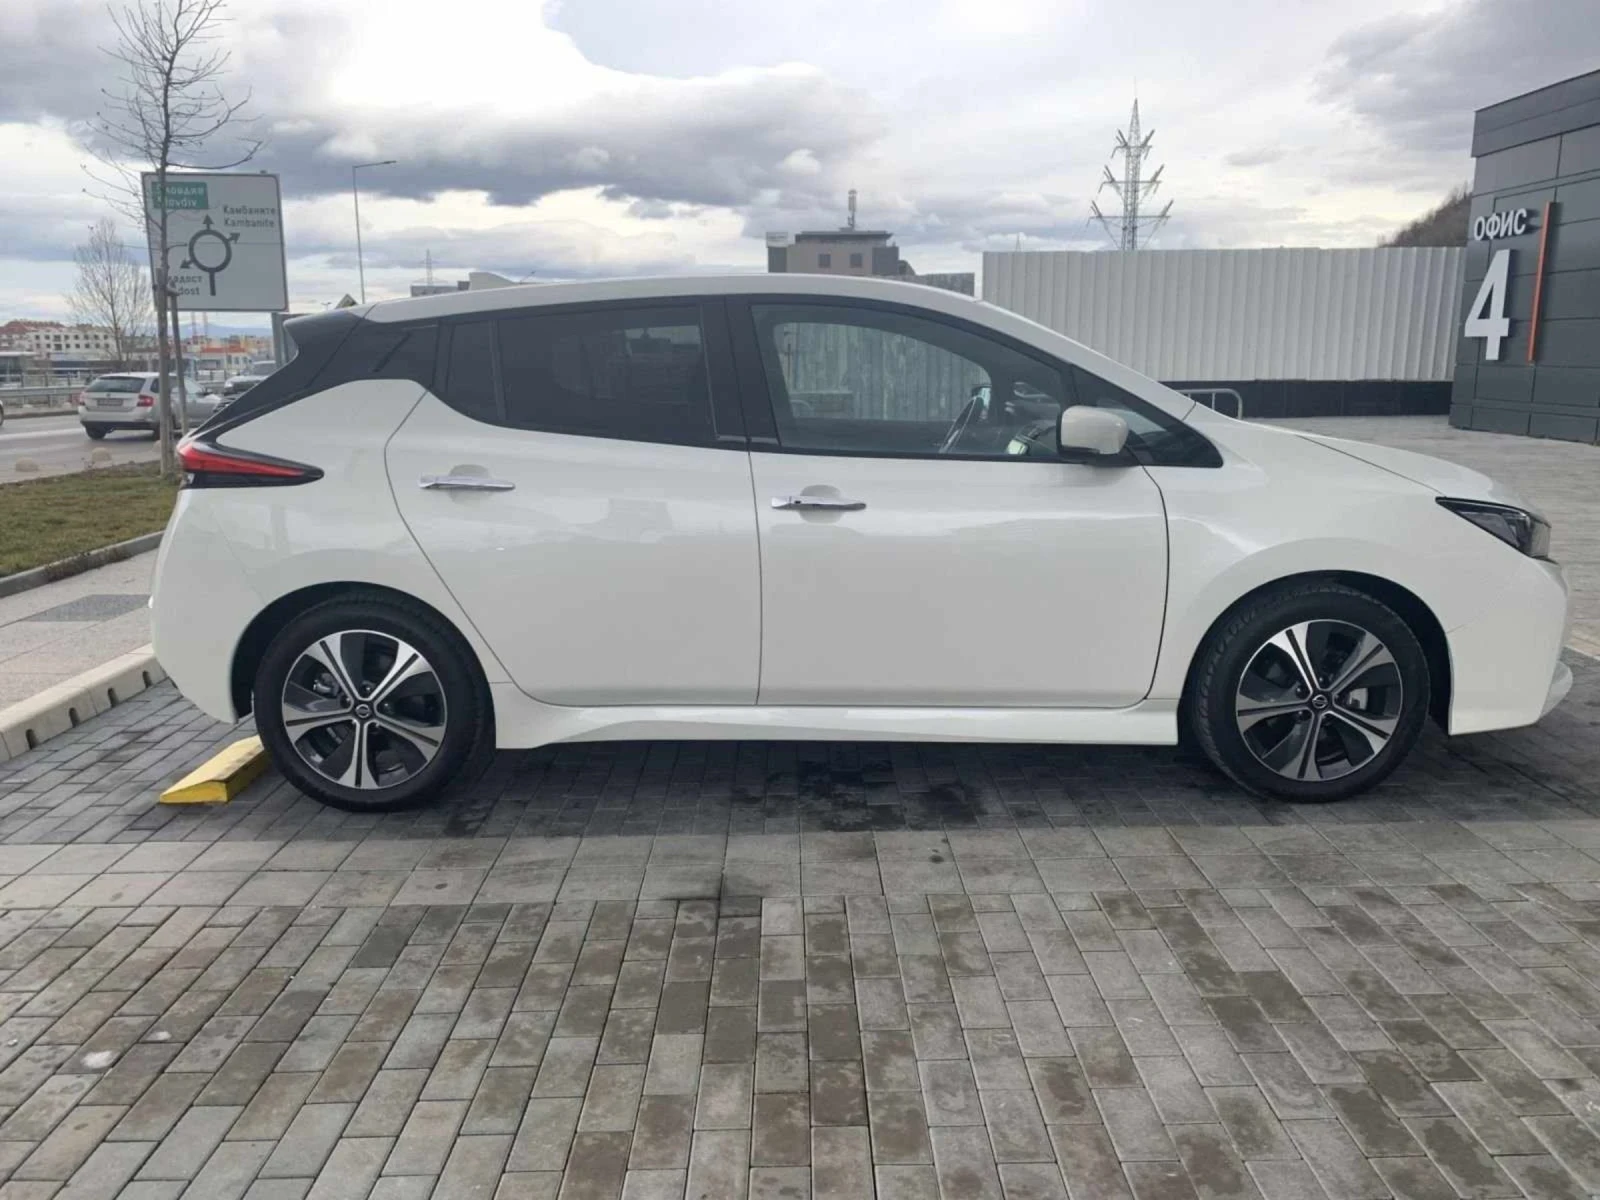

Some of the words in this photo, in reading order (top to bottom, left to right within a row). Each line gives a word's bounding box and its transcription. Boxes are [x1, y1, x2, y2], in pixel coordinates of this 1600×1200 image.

[224, 217, 275, 228] Kambanite
[1473, 208, 1527, 241] ОФИС
[167, 275, 202, 284] ладост
[1464, 248, 1510, 361] 4
